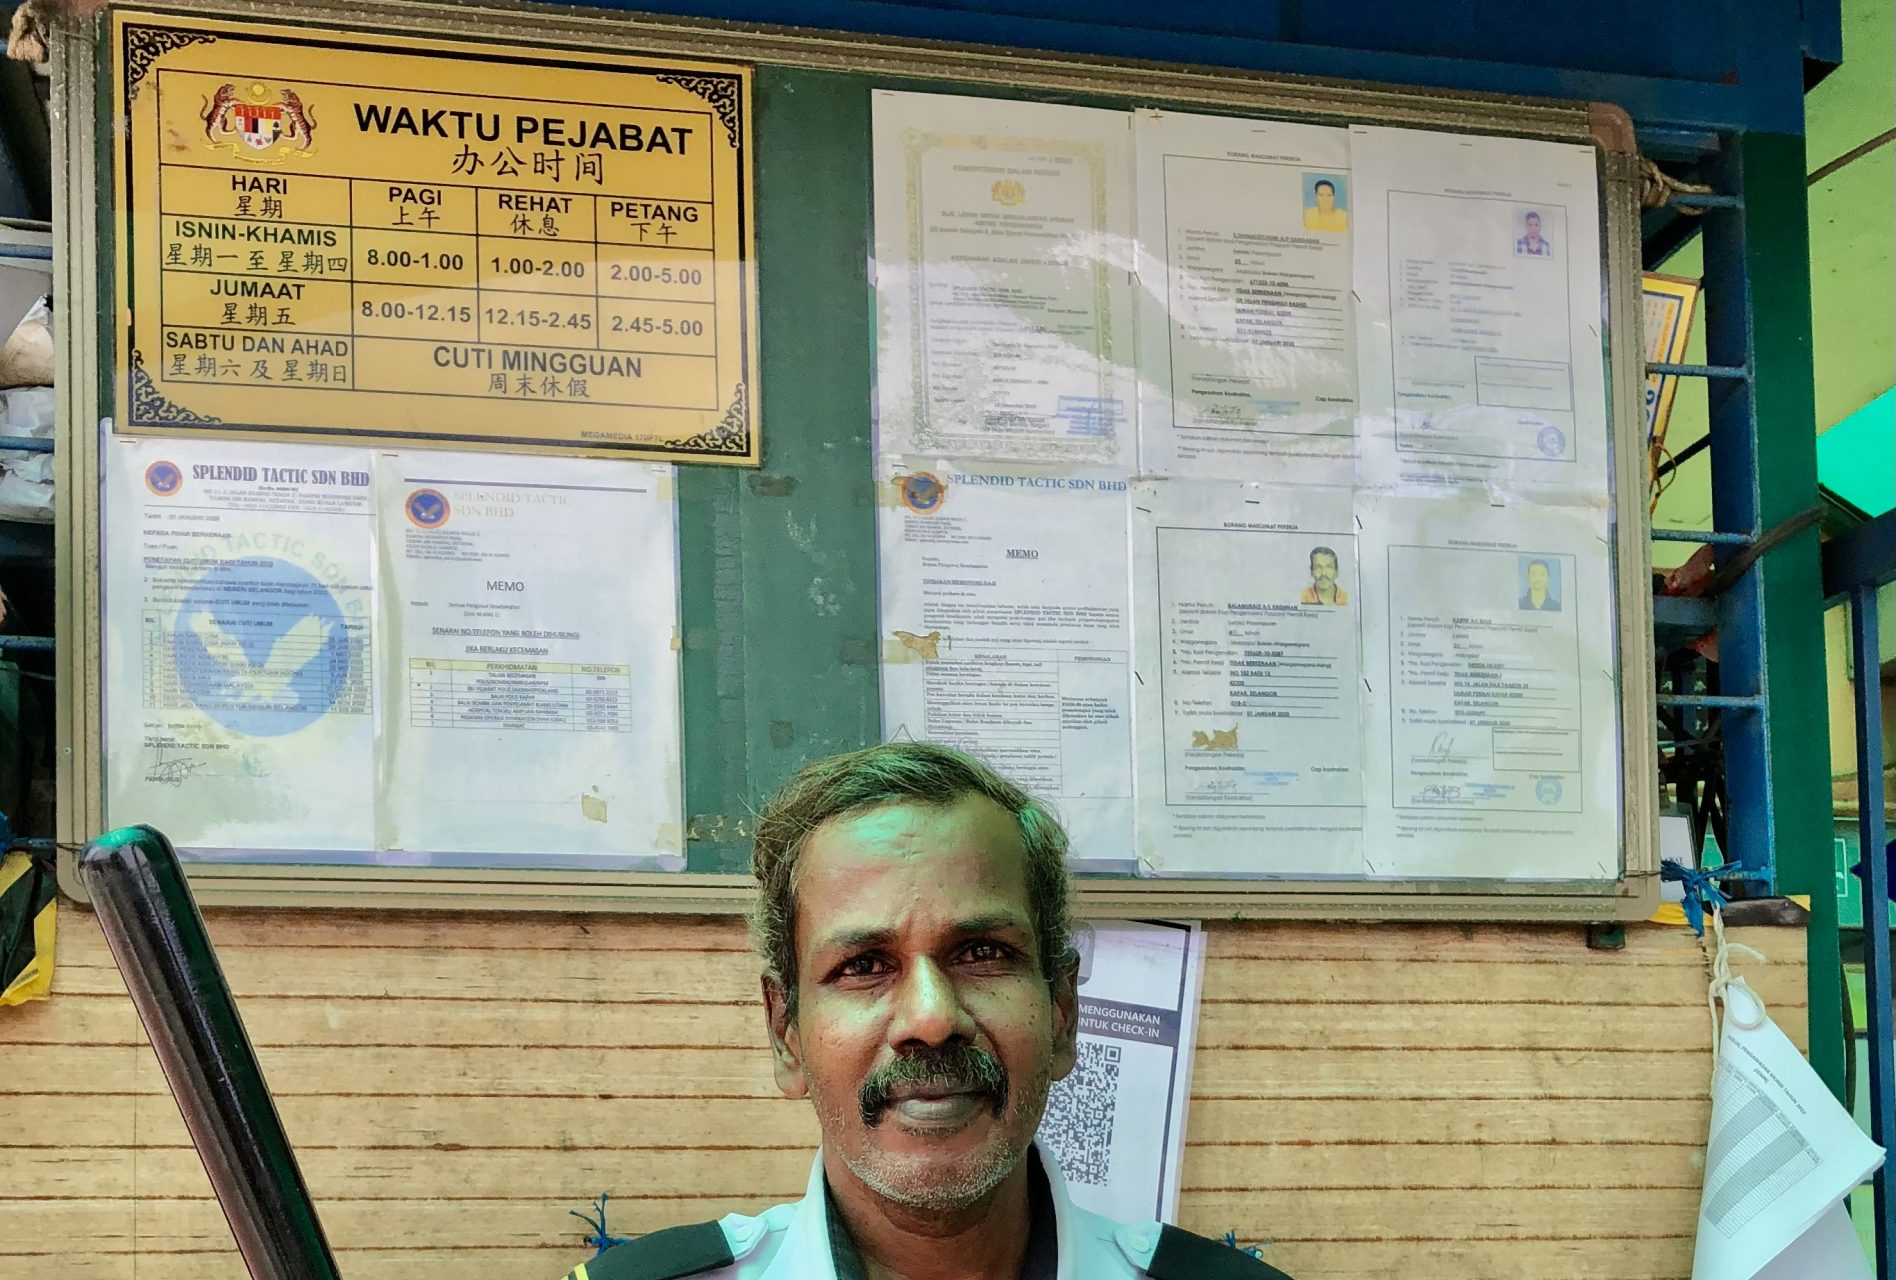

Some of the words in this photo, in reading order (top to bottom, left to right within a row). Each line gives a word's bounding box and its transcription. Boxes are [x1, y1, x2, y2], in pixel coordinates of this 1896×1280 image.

[354, 103, 500, 143] WAKTU
[516, 115, 693, 156] PEJABAT
[452, 145, 604, 186] 办公时间
[231, 175, 288, 197] HARI
[388, 186, 442, 207] PAGI
[234, 196, 284, 220] 星期
[498, 194, 572, 215] REHAT
[610, 202, 699, 224] PETANG
[392, 206, 441, 230] 上午
[511, 213, 559, 237] 休息
[175, 221, 337, 249] ISNIN-KHAMIS
[631, 222, 677, 246] 下午
[367, 251, 464, 272] 8.00-1.00
[491, 257, 585, 280] 1.00-2.00
[610, 264, 702, 287] 2.00-5.00
[210, 280, 305, 301] JUMAAT
[221, 303, 296, 327] 星期五
[362, 301, 471, 324] 8.00-12.15
[485, 308, 591, 331] 12.15-2.45
[612, 315, 703, 338] 2.45-5.00
[166, 332, 235, 354] SABTU
[241, 336, 286, 356] DAN
[290, 338, 348, 359] AHAD
[434, 347, 494, 371] CUTI
[502, 351, 642, 379] MINGGUAN
[488, 373, 589, 398] 周末休假
[581, 430, 632, 440] MEGAMEDIA
[192, 464, 258, 482] SPLENDID
[262, 467, 308, 485] TACTIC
[312, 469, 336, 486] SDN
[341, 470, 370, 487] BHD
[947, 473, 1015, 486] SPLENDID
[1018, 476, 1065, 489] TACTIC
[1068, 478, 1095, 489] SDN
[1099, 480, 1127, 492] BHD
[454, 491, 521, 504] SPLENDID
[486, 507, 514, 518] BHD
[1006, 548, 1039, 559] MEMO
[486, 580, 525, 592] MEMO
[486, 663, 538, 671] PERKHIDMATAN
[1078, 1004, 1161, 1025] MENGGUNAKAN
[1111, 1021, 1160, 1038] CHECK-IN
